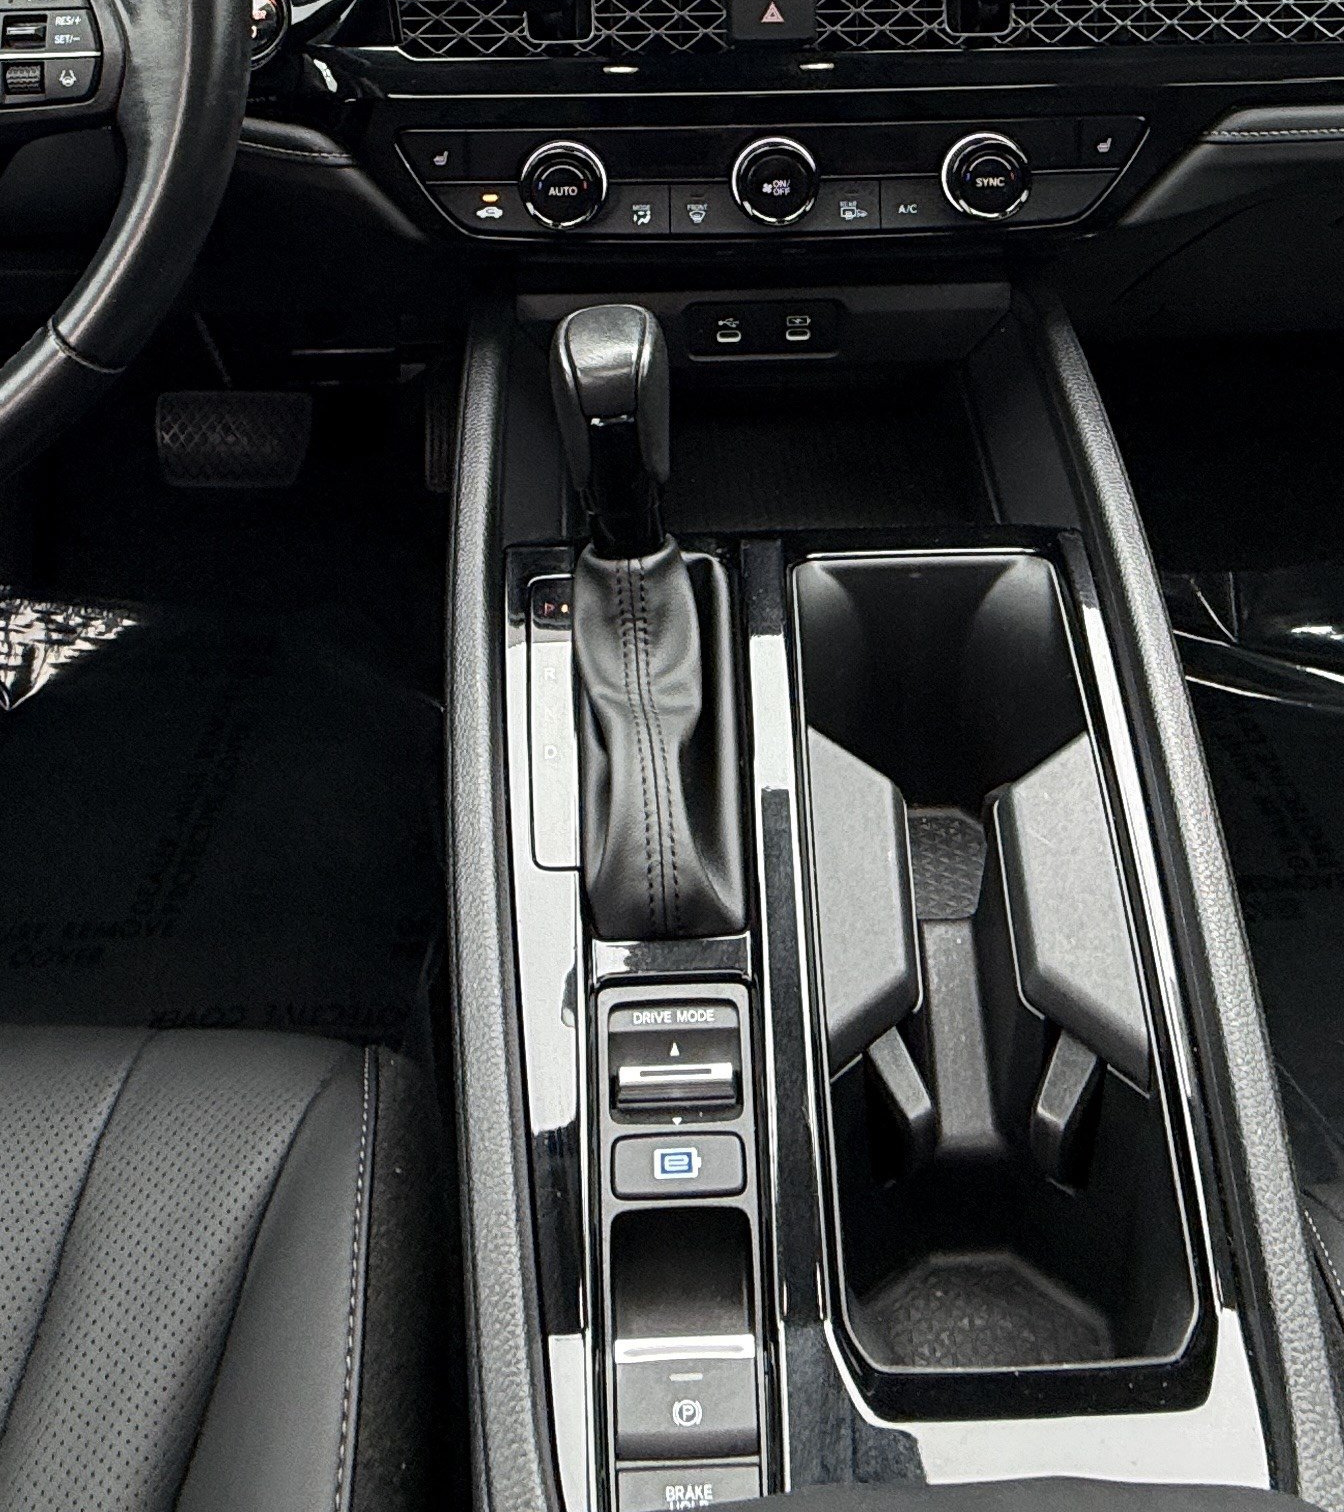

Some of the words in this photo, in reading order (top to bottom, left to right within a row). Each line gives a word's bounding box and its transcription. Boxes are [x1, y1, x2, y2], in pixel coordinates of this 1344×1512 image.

[54, 15, 82, 26] RES/+
[773, 179, 791, 188] ON/
[975, 177, 1005, 187] SYNC
[548, 186, 578, 196] AUTO
[773, 188, 791, 196] OFF
[687, 203, 708, 211] FRONT
[898, 203, 918, 214] A/C
[632, 1010, 672, 1025] DRIVE
[676, 1009, 715, 1023] MODE
[665, 1483, 714, 1502] BRAKE
